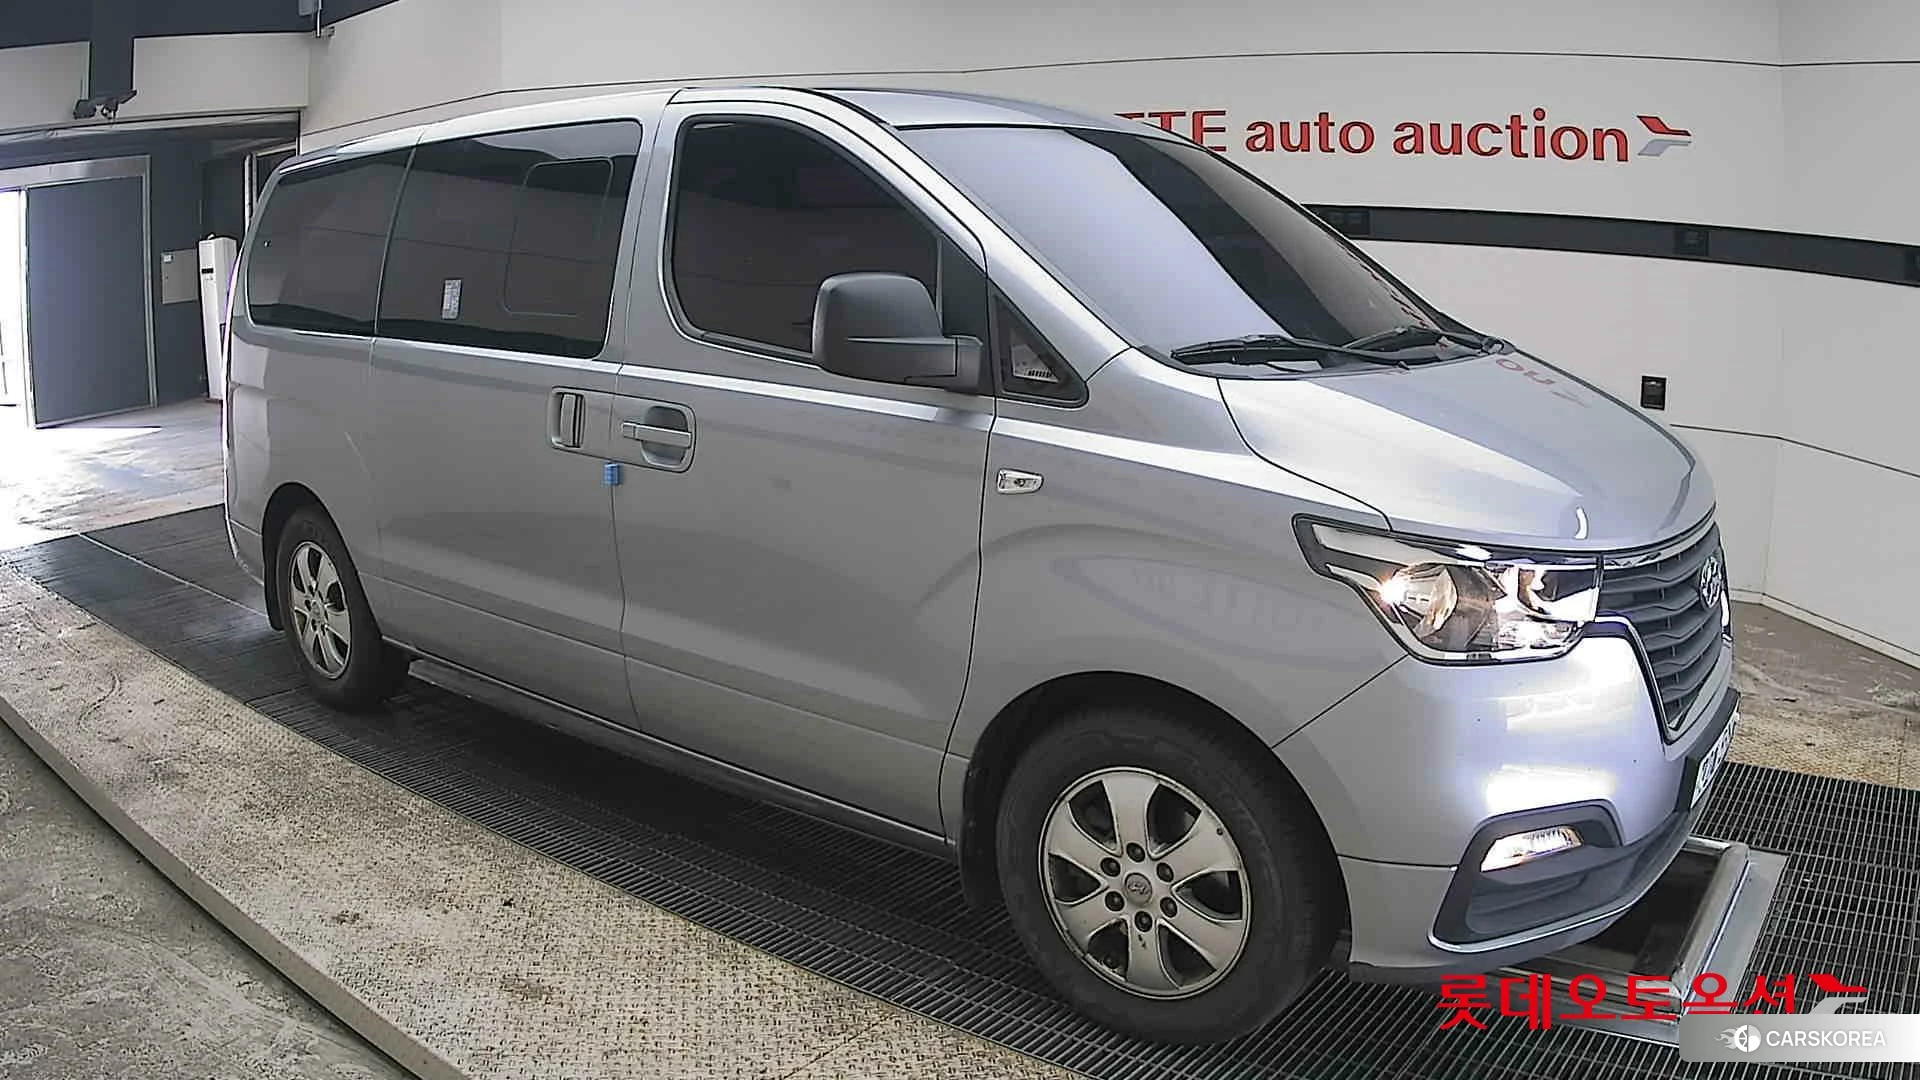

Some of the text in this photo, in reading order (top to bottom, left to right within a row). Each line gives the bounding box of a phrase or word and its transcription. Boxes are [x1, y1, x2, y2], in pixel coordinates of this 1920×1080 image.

[1114, 108, 1629, 161] TE auto auction
